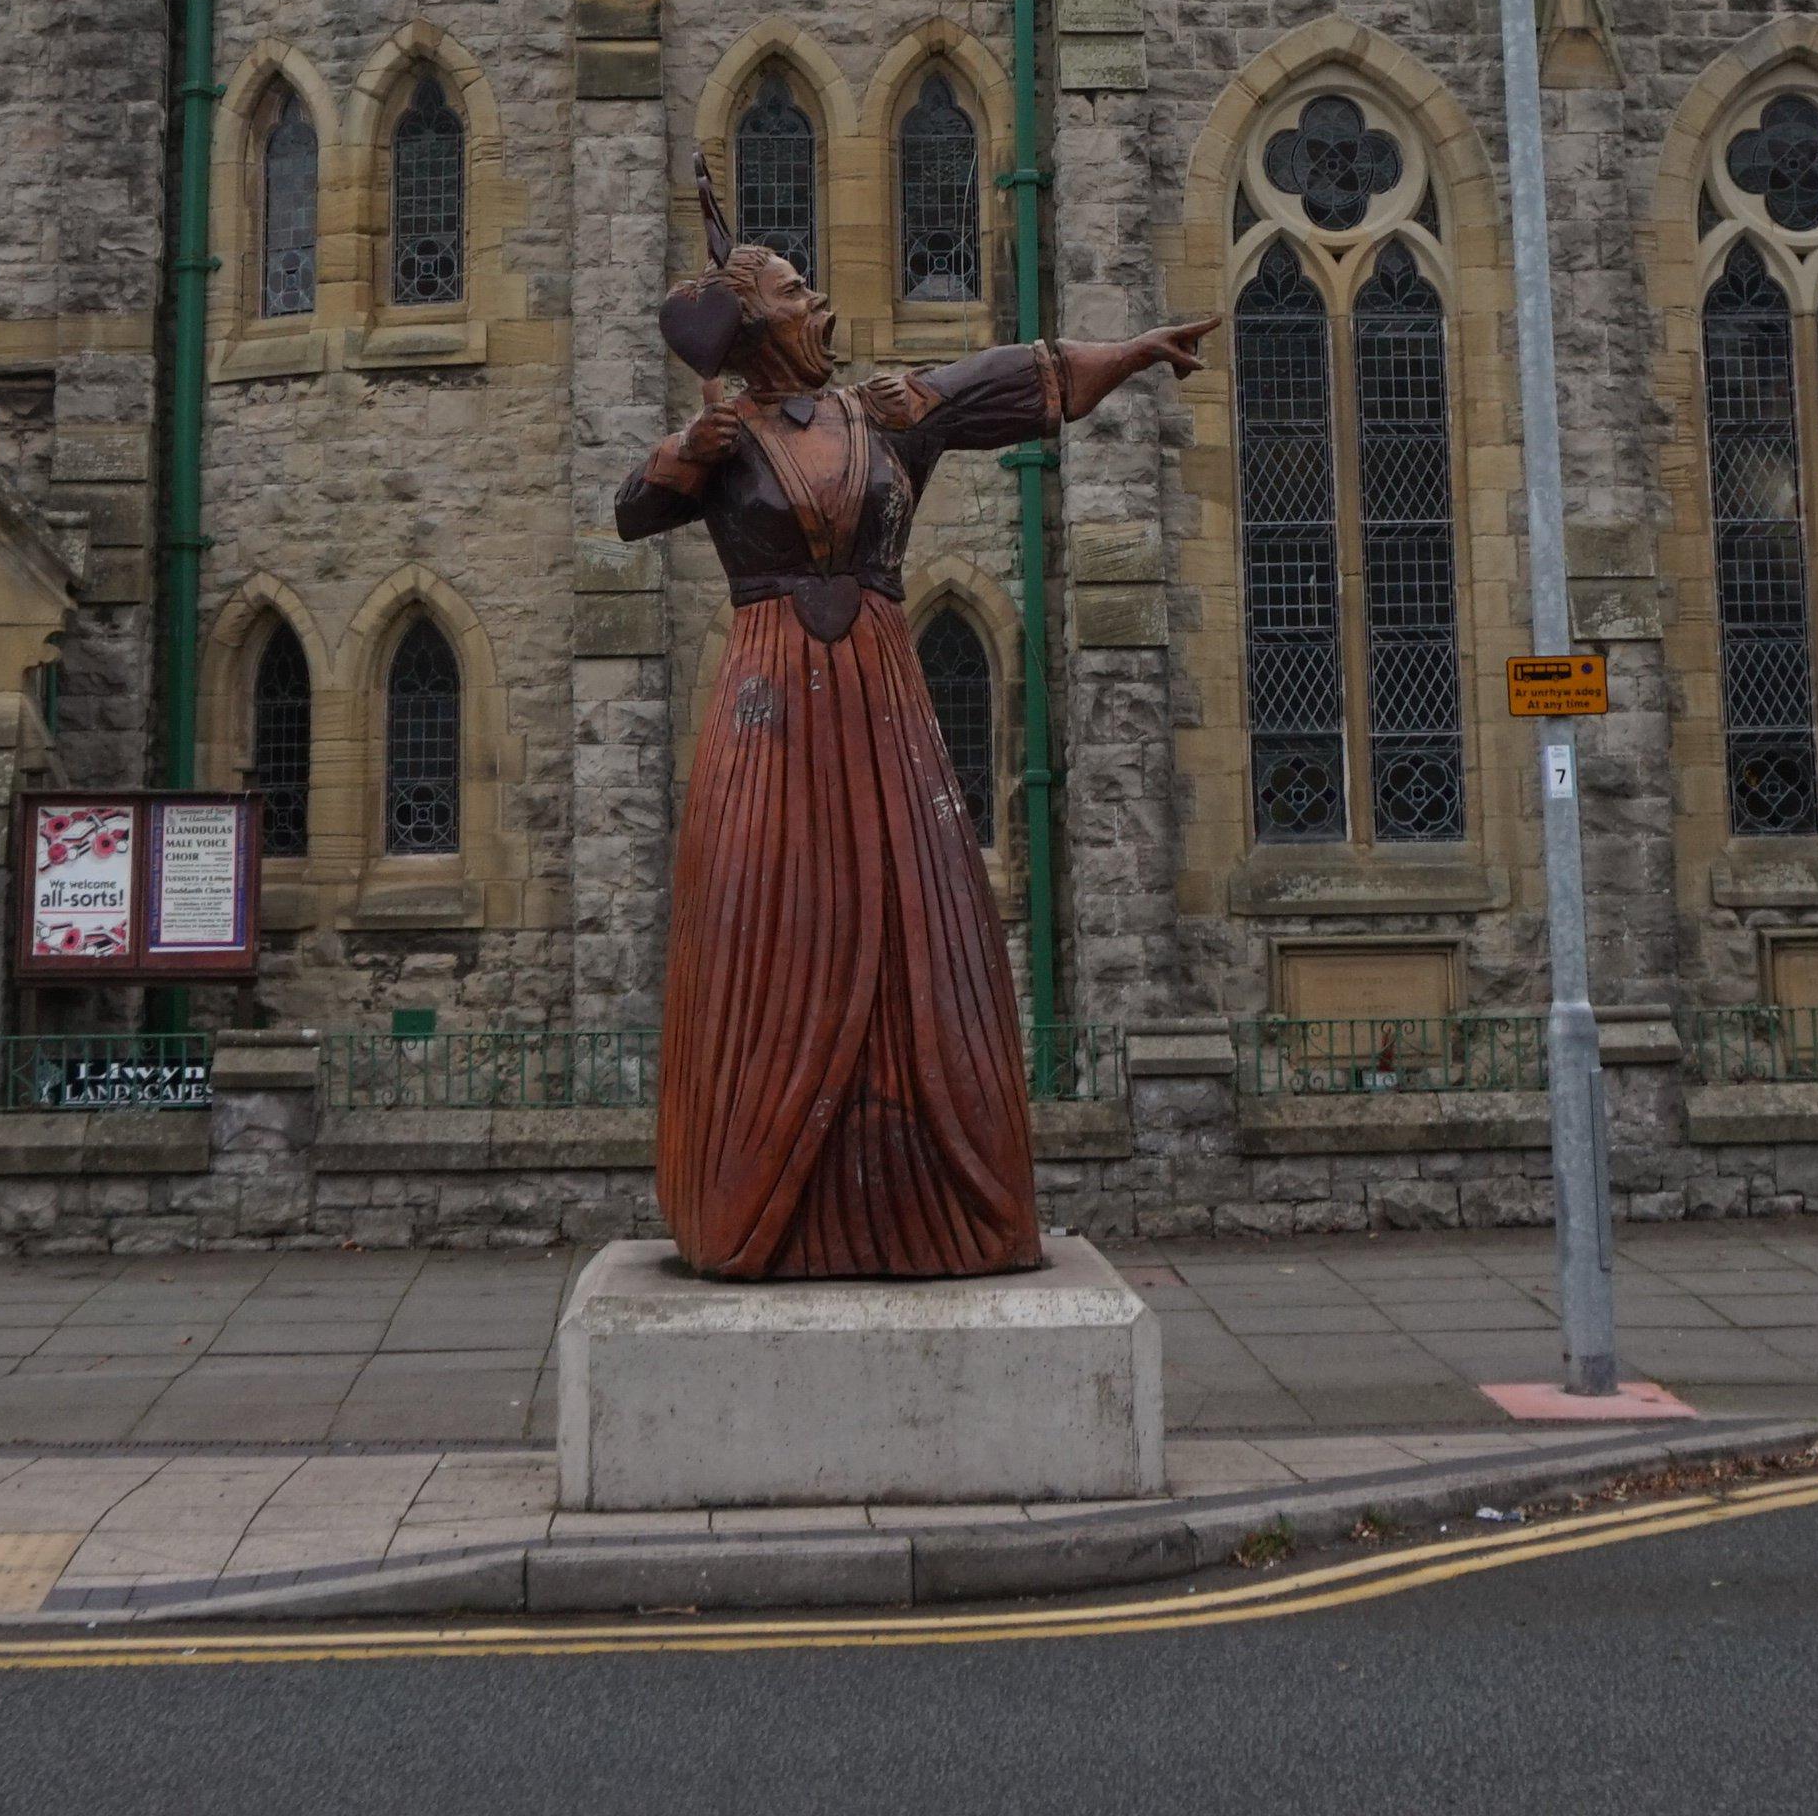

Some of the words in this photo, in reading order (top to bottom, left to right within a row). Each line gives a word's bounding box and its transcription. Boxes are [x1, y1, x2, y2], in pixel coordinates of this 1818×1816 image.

[1527, 700, 1539, 709] At
[1543, 701, 1563, 711] any
[1566, 699, 1590, 709] time
[1555, 768, 1566, 784] 7
[165, 839, 193, 849] MALE
[196, 839, 228, 848] VOICE
[165, 852, 199, 861] CHOIR
[49, 879, 66, 890] We
[70, 878, 117, 890] welcome
[40, 889, 124, 908] all-sorts!
